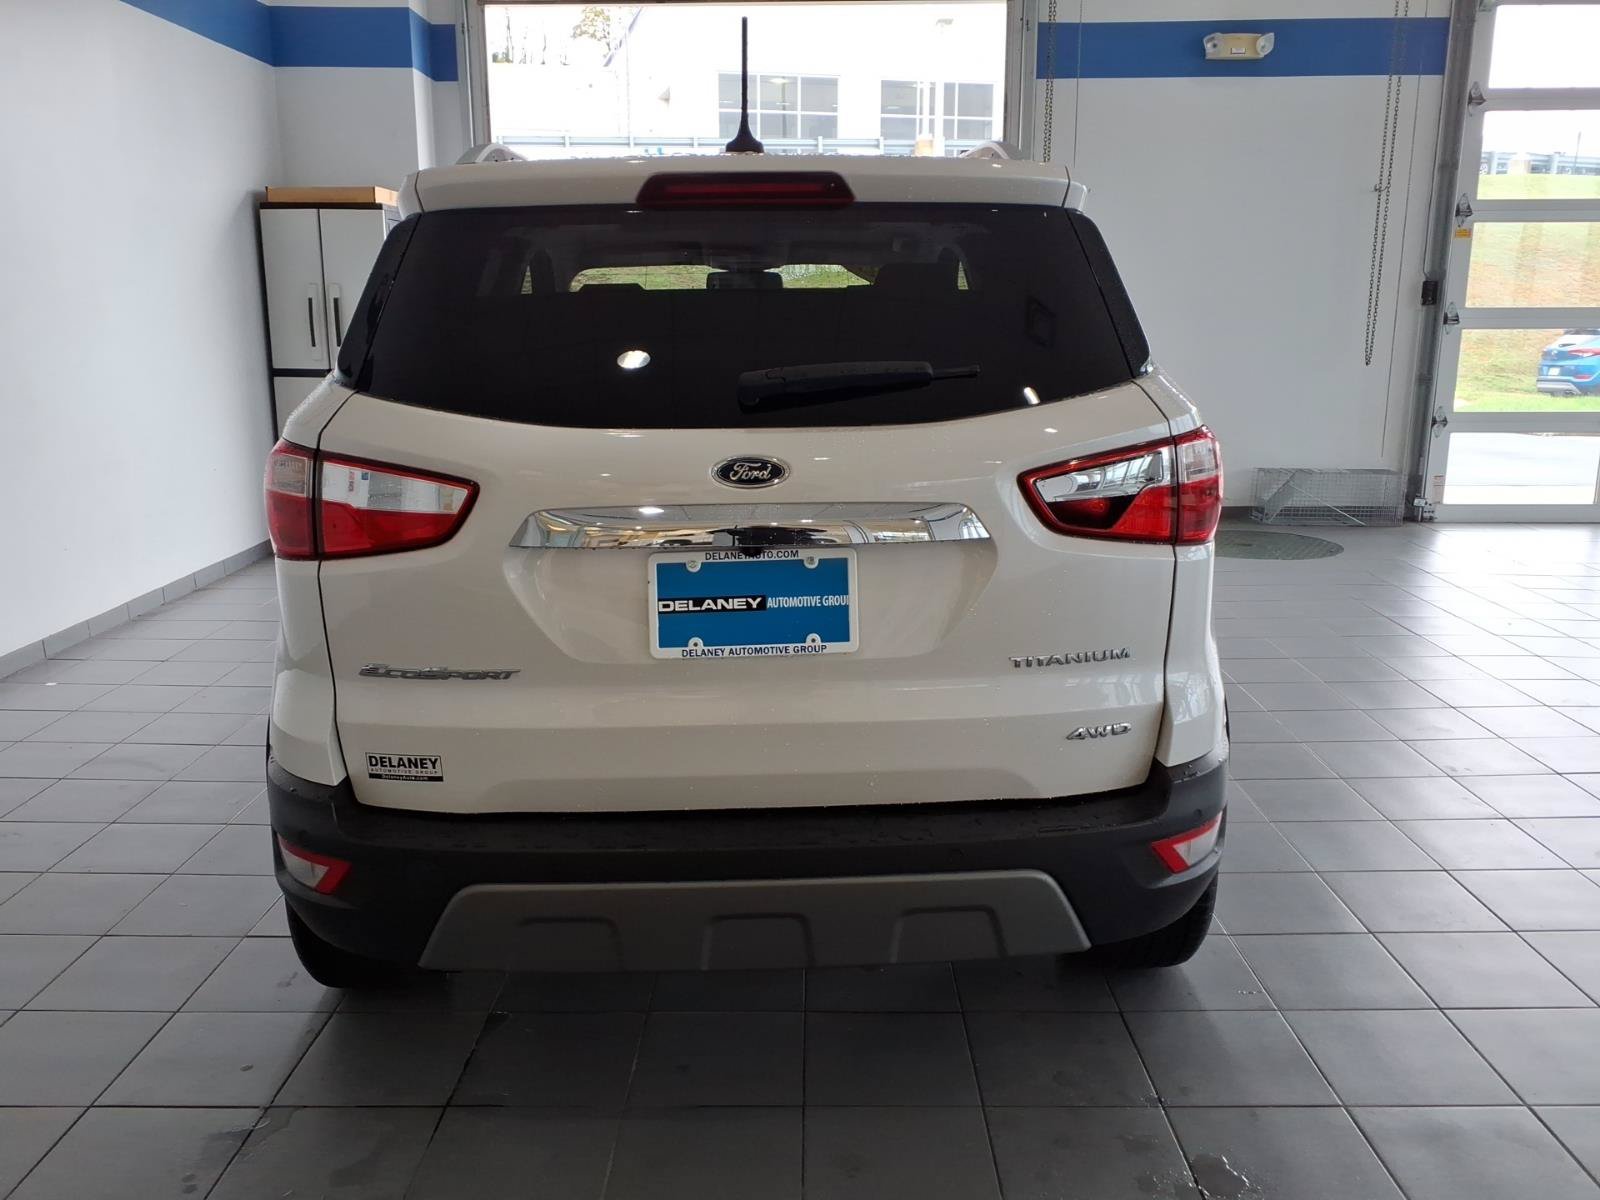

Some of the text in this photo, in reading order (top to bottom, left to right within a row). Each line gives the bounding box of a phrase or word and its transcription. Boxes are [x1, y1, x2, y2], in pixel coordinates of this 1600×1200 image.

[729, 461, 771, 481] Ford
[658, 598, 762, 612] DELANEY
[767, 595, 821, 608] AUTOMOTIVE
[681, 645, 827, 658] DELANEY AUTOMOTIVE GROUP
[1008, 647, 1131, 668] TITANIUM
[1065, 722, 1131, 740] 4WD
[368, 755, 439, 770] DELANEY
